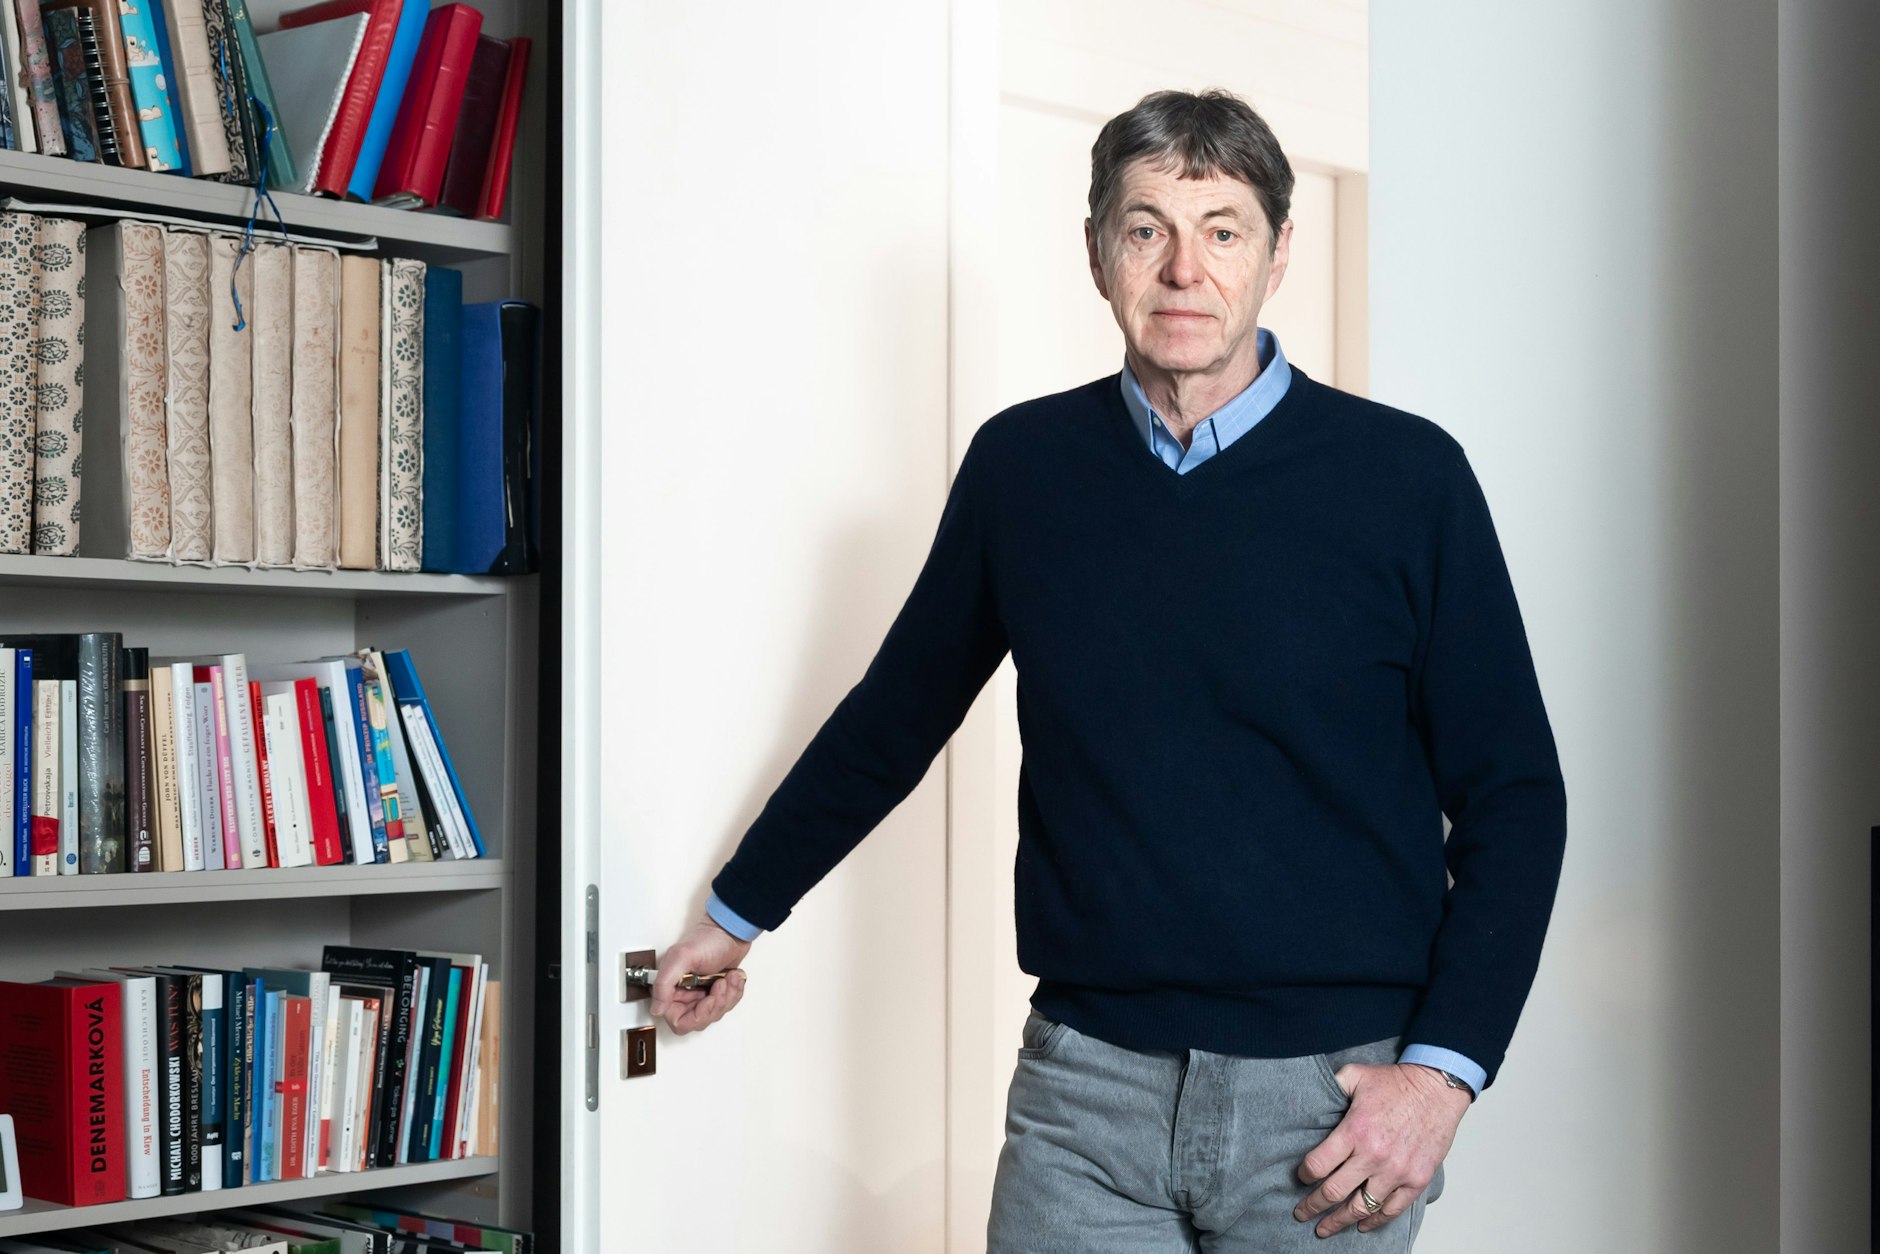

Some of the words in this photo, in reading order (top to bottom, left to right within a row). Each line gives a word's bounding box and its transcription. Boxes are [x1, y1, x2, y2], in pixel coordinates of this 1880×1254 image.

[235, 666, 244, 698] RITTER
[356, 683, 367, 721] RUSSLAND
[44, 722, 52, 758] Vielleicht
[238, 703, 250, 753] GEFALLENE
[362, 723, 372, 752] PRINZIP
[44, 768, 53, 816] Petrowskaja
[262, 759, 272, 794] NAWALNY
[3, 798, 12, 818] der
[249, 794, 258, 843] CONSTANTIN
[266, 796, 275, 824] ALEXEI
[168, 983, 178, 1018] TUN?
[397, 975, 412, 1043] BELONGING
[168, 1022, 179, 1052] WAS
[84, 997, 107, 1174] DENEMARKOVÁ
[141, 1068, 152, 1122] Entscheidung
[168, 1057, 181, 1136] CHODORKOWSKI
[190, 1069, 198, 1110] BRESLAU
[390, 1086, 400, 1118] Toko-pa
[291, 1097, 299, 1115] EGER
[144, 1124, 152, 1133] in
[190, 1114, 199, 1142] JAHRE
[290, 1132, 298, 1153] EDITH
[388, 1120, 397, 1144] Turner
[144, 1136, 152, 1156] Kiew
[169, 1138, 182, 1181] MICHAIL
[190, 1144, 199, 1165] 1000
